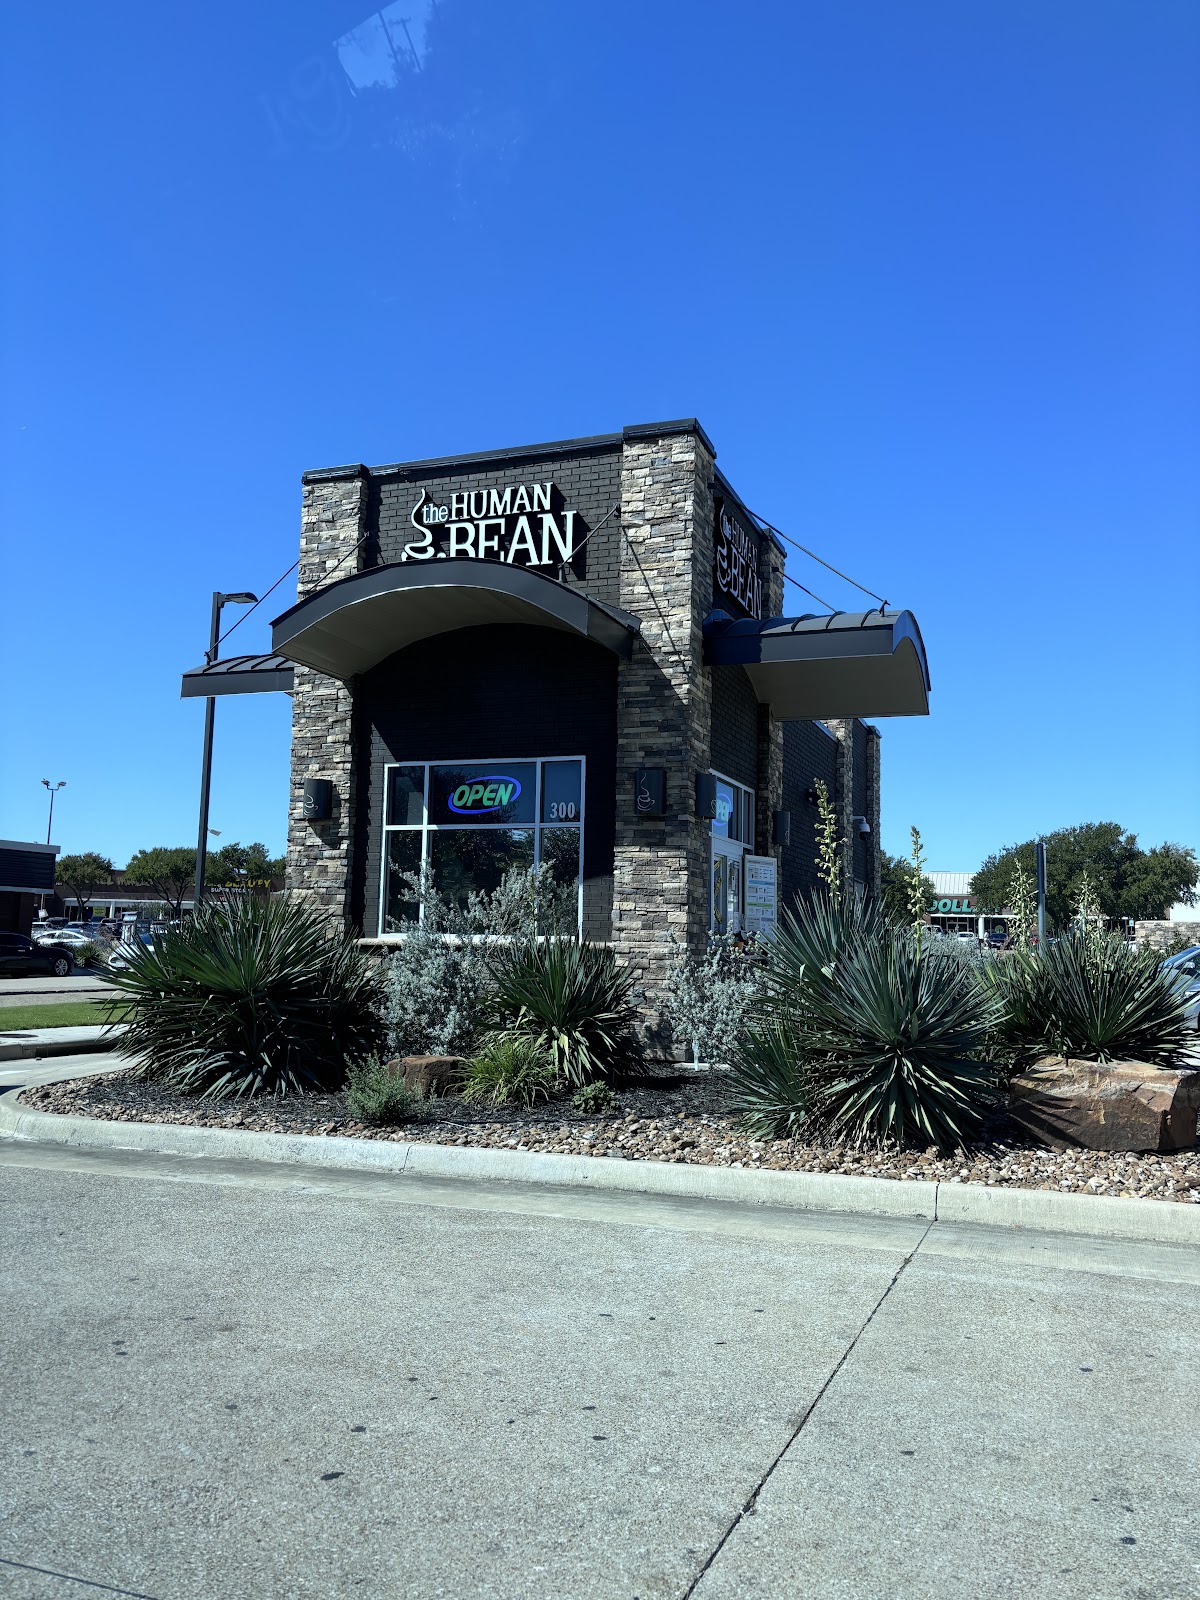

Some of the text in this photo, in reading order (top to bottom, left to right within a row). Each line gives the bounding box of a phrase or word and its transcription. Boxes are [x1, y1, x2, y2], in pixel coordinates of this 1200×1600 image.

[421, 481, 554, 525] the HUMAN
[444, 510, 578, 566] BEAN
[730, 543, 762, 620] BEAN
[452, 783, 514, 807] OPEN
[549, 801, 576, 819] 300
